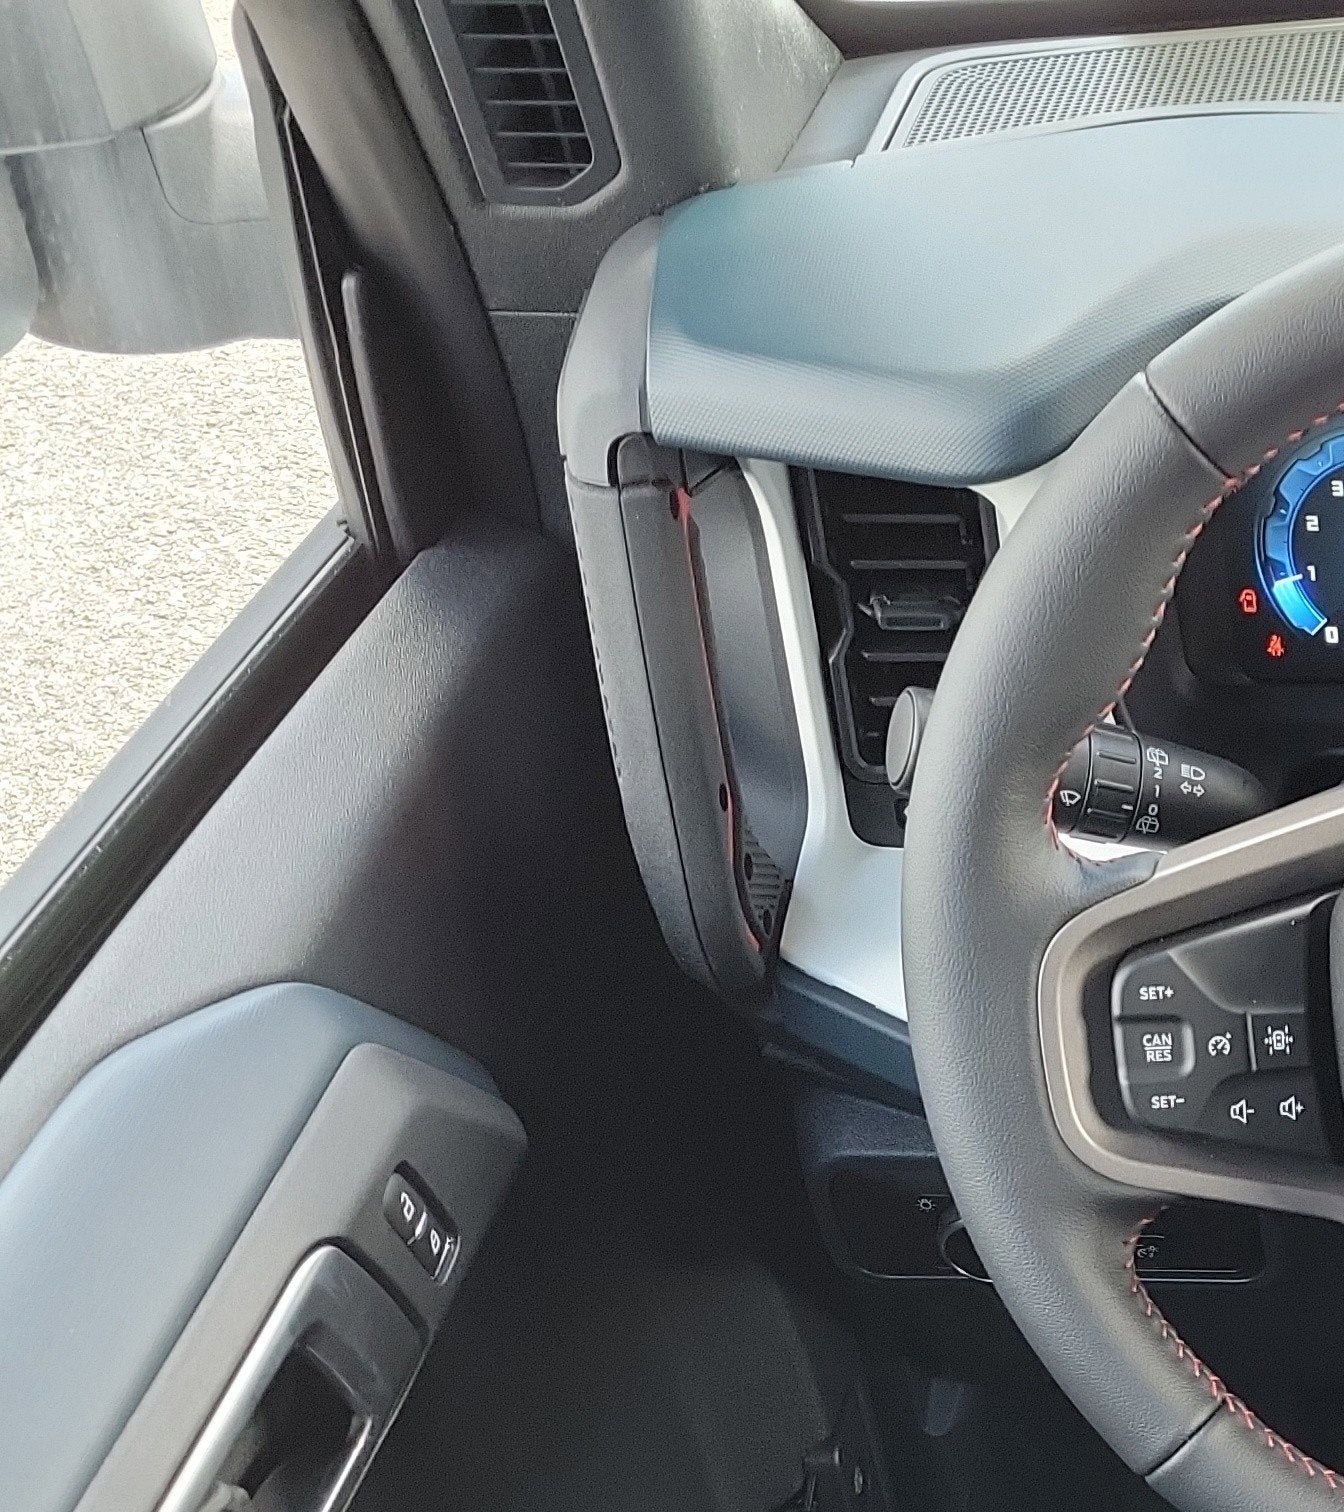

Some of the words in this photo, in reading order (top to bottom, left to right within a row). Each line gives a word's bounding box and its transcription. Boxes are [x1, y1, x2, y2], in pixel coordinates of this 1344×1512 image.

[1332, 481, 1344, 497] 3
[1306, 516, 1320, 531] 2
[1307, 566, 1317, 581] 1
[1324, 627, 1339, 644] 0
[1153, 767, 1163, 779] 2
[1139, 985, 1175, 1001] SET+
[1142, 1033, 1173, 1048] CAN
[1146, 1048, 1173, 1062] RES
[1151, 1094, 1186, 1109] SET-
